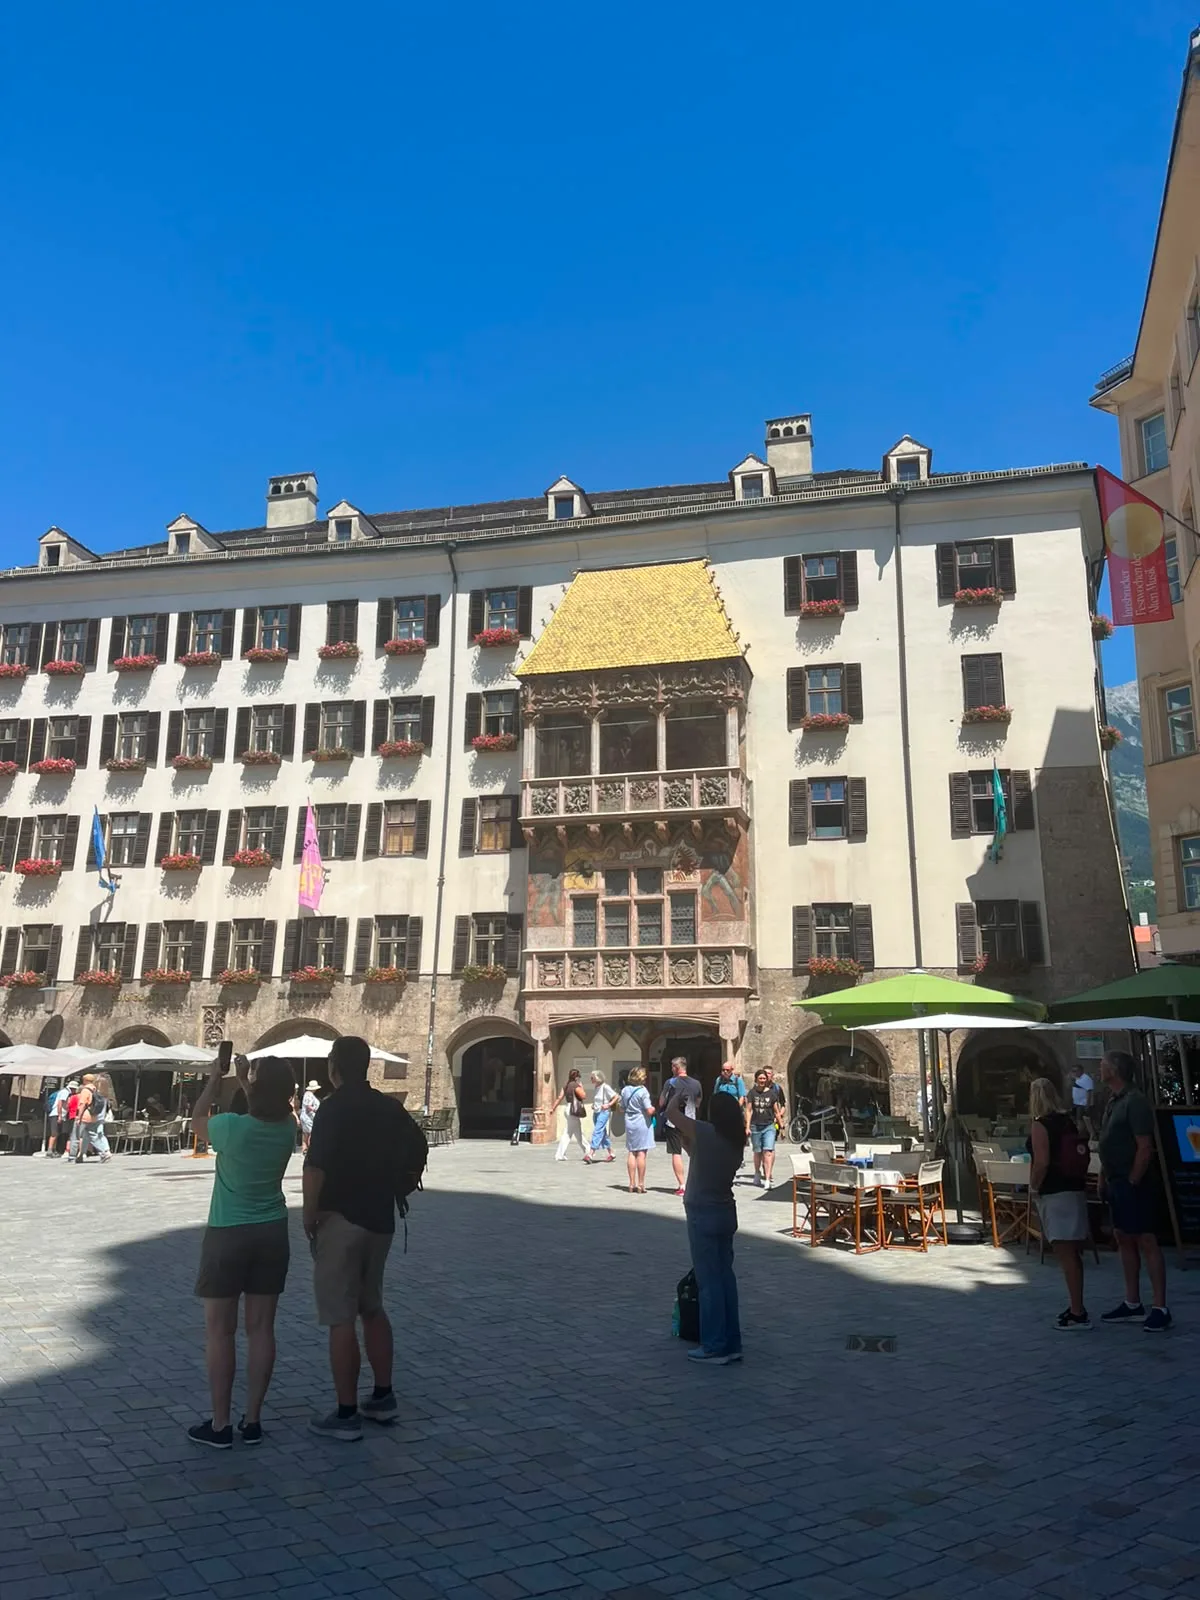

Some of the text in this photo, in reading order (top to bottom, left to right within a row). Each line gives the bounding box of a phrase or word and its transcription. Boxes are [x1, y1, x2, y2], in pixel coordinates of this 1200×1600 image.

[1120, 569, 1133, 618] Innsbrucker
[1131, 552, 1146, 616] Festwochen der
[1144, 566, 1157, 591] Musik
